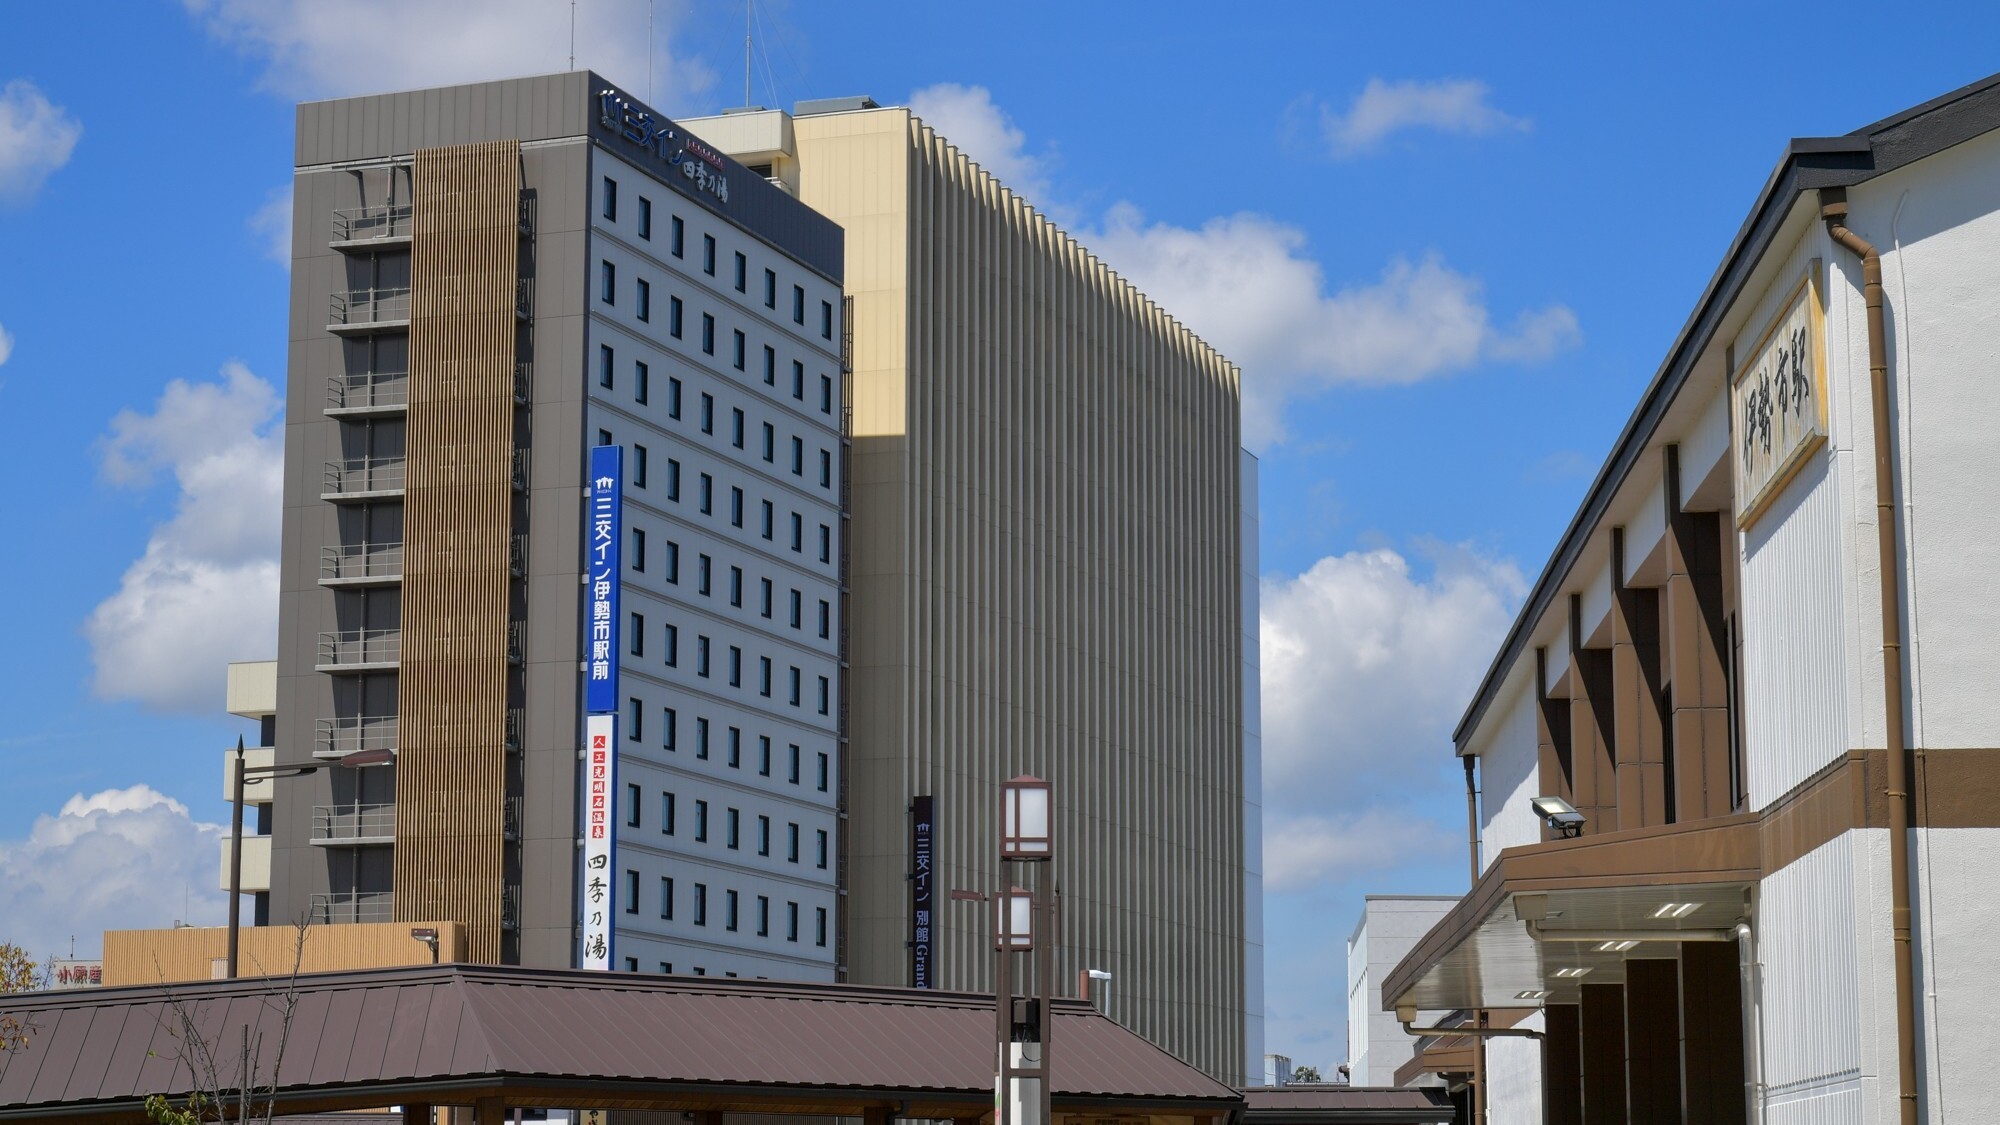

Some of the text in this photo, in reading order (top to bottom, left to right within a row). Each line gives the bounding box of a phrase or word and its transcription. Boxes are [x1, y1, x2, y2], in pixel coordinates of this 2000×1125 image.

[683, 160, 729, 204] 四季乃湯
[1743, 326, 1809, 476] 伊勢市駅
[592, 497, 612, 680] 三交イン伊勢市駅前
[592, 736, 606, 838] 人工光明石温泉
[585, 854, 608, 960] 四季乃湯
[916, 838, 930, 902] 三交イン
